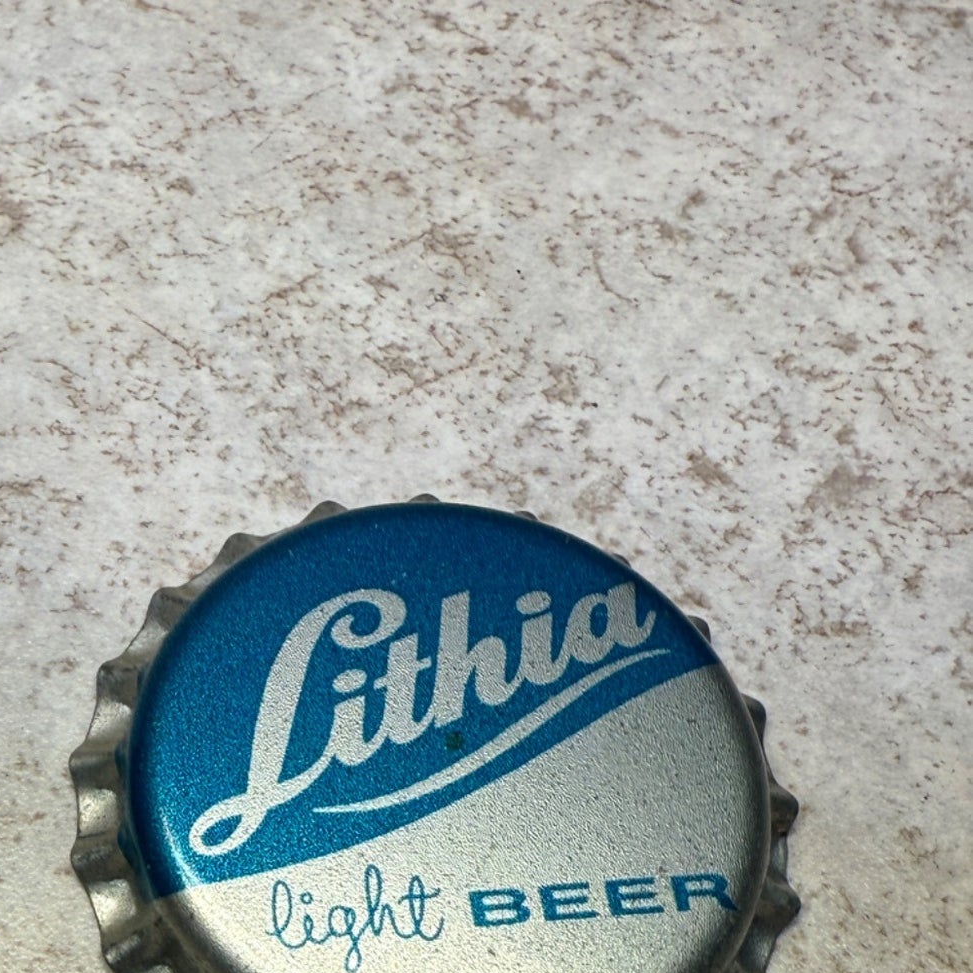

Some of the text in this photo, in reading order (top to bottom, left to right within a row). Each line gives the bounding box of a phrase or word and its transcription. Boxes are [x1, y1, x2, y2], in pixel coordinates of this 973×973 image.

[188, 580, 658, 857] Lithia
[265, 864, 739, 973] light BEER
